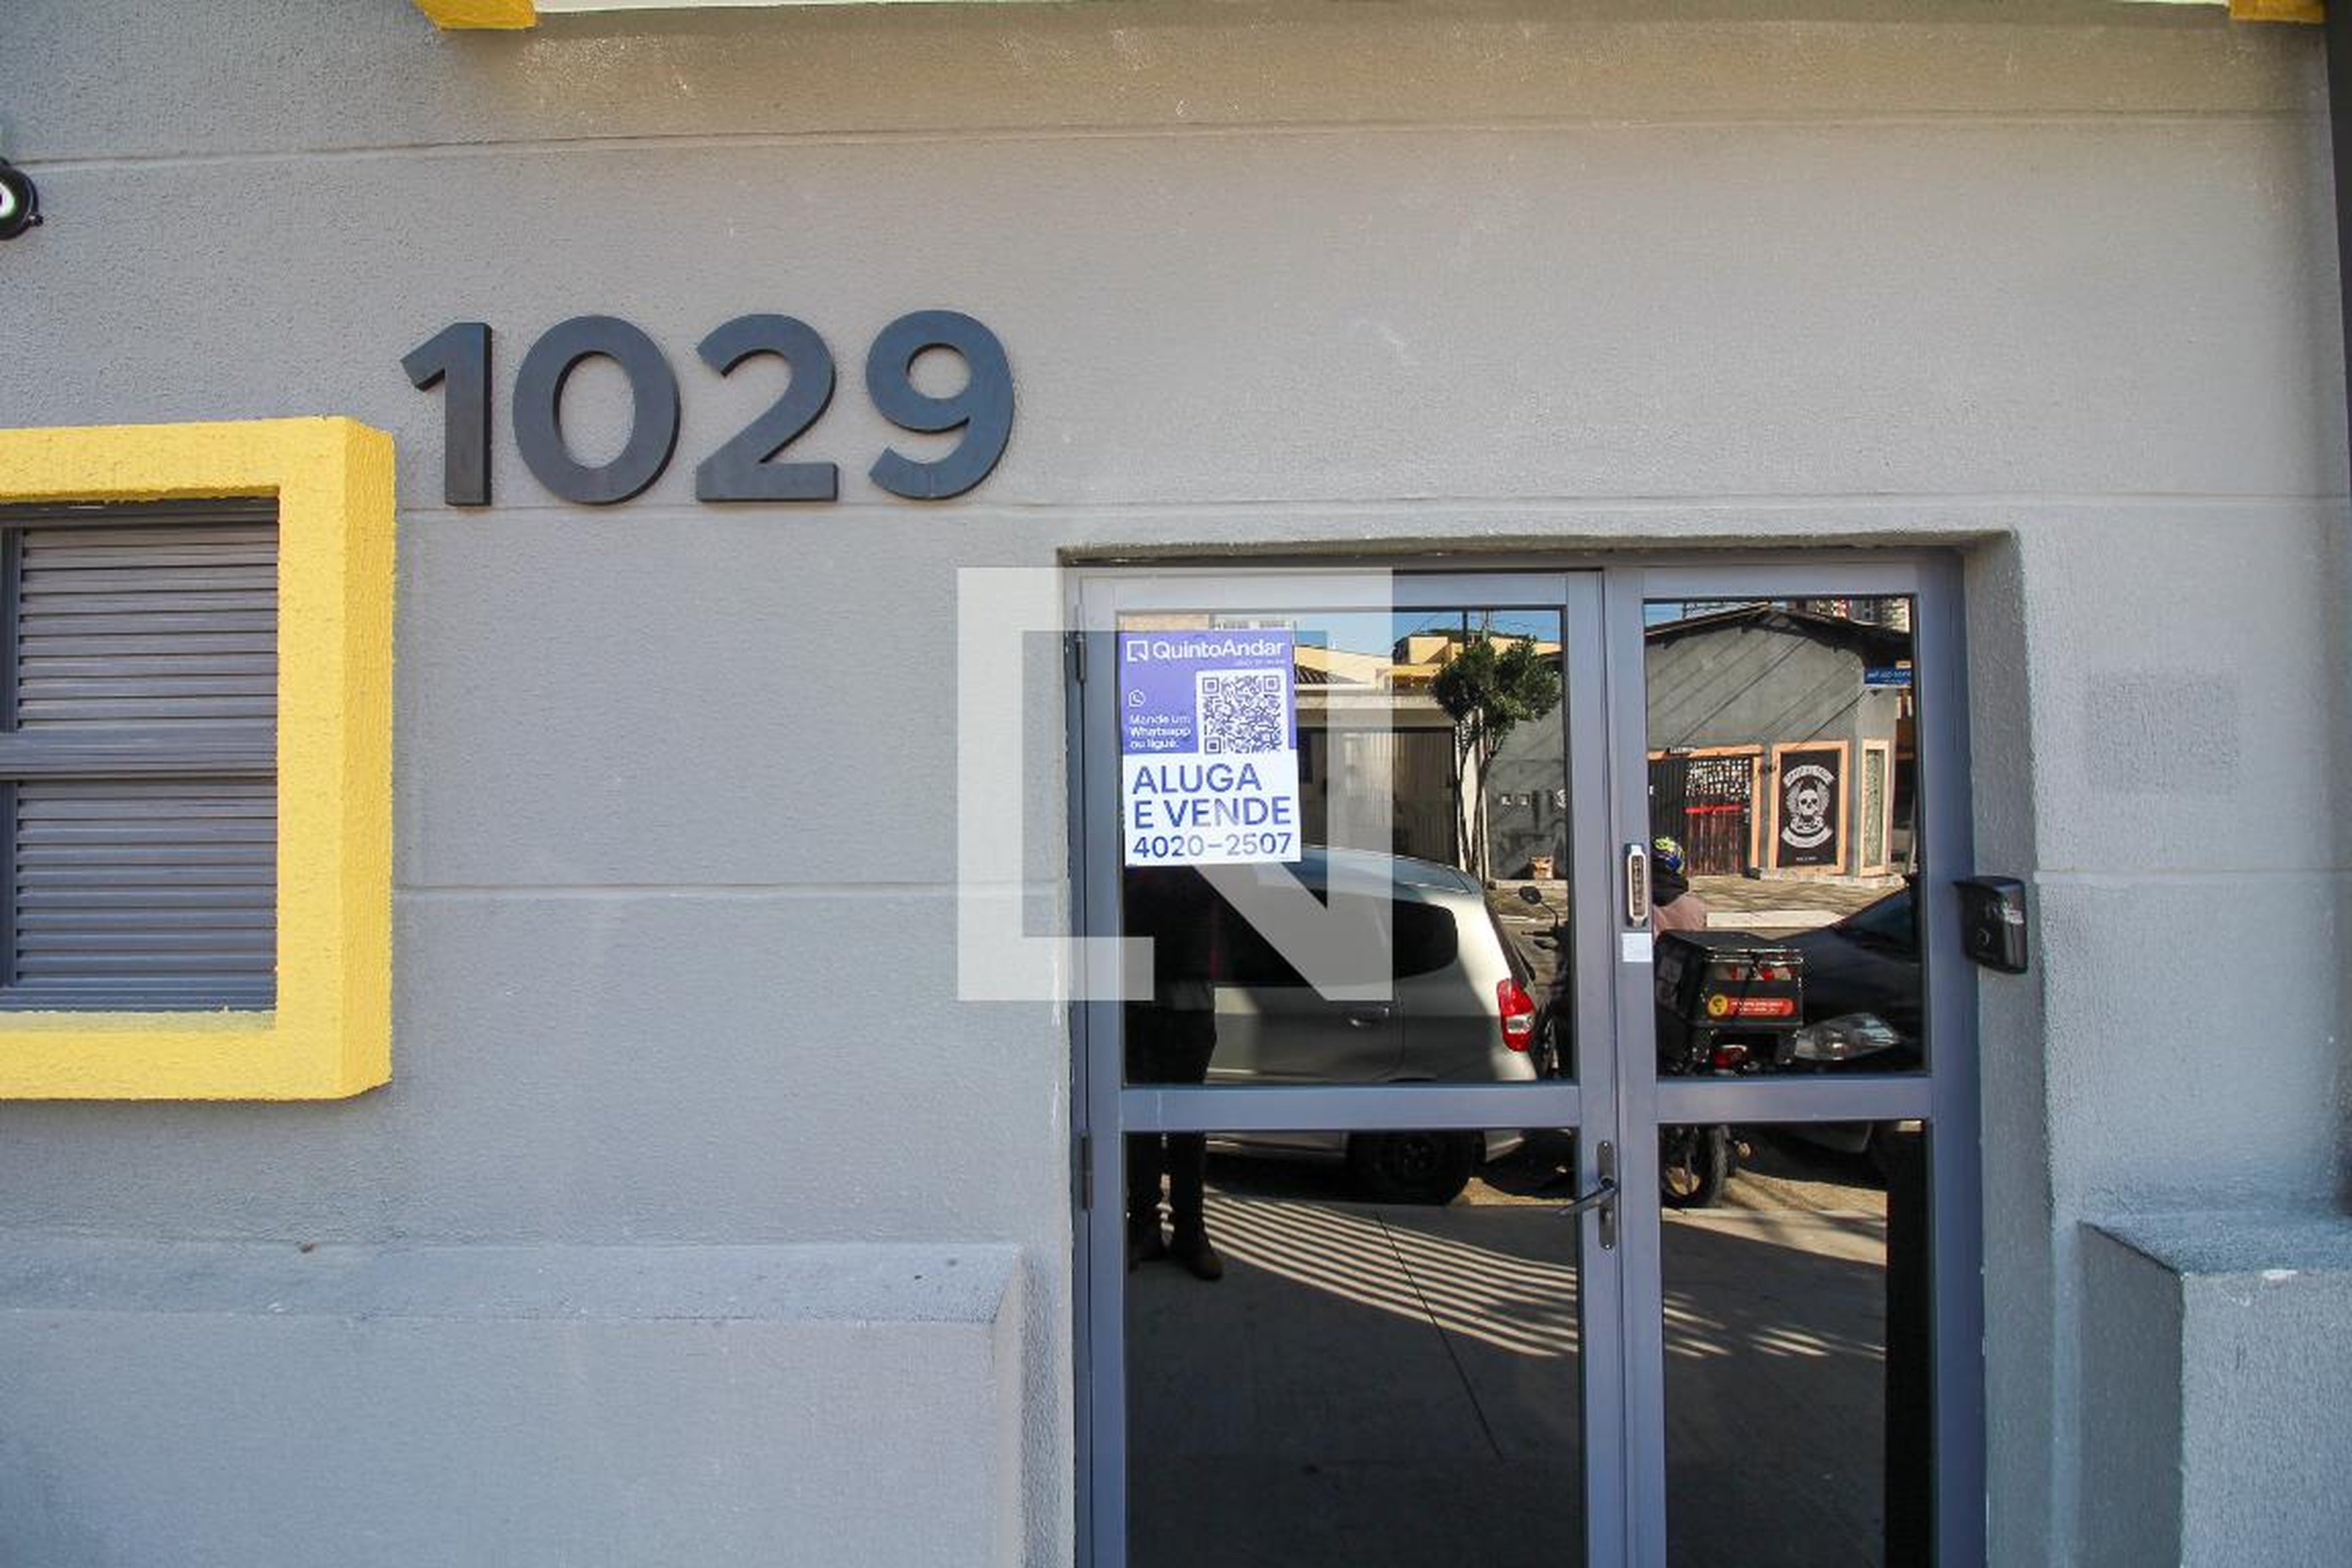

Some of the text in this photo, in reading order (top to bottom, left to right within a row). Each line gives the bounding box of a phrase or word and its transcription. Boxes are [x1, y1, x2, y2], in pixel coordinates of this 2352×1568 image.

[401, 309, 1016, 507] 1029
[1152, 639, 1285, 659] QuintoAndar
[1133, 763, 1262, 794] ALUGA
[1134, 796, 1291, 829] E VENDE
[1133, 832, 1292, 858] 4020-2507
